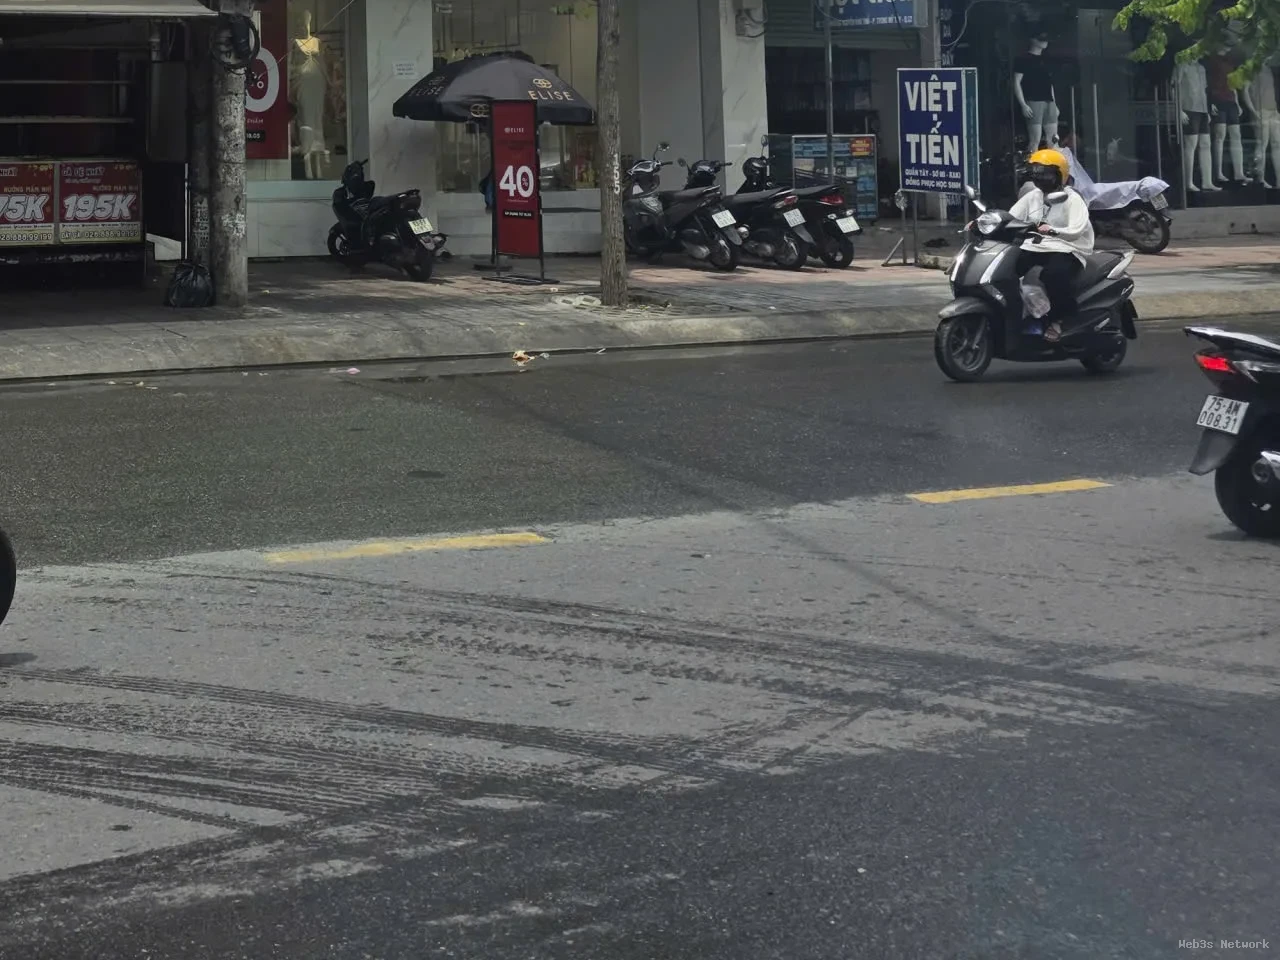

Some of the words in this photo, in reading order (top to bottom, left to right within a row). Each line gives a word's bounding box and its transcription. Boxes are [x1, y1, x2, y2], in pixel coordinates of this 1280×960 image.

[528, 90, 574, 101] ELISE
[904, 74, 957, 121] VIỆT
[906, 121, 960, 166] TIẾN
[499, 165, 534, 198] 40
[63, 193, 137, 222] 195K
